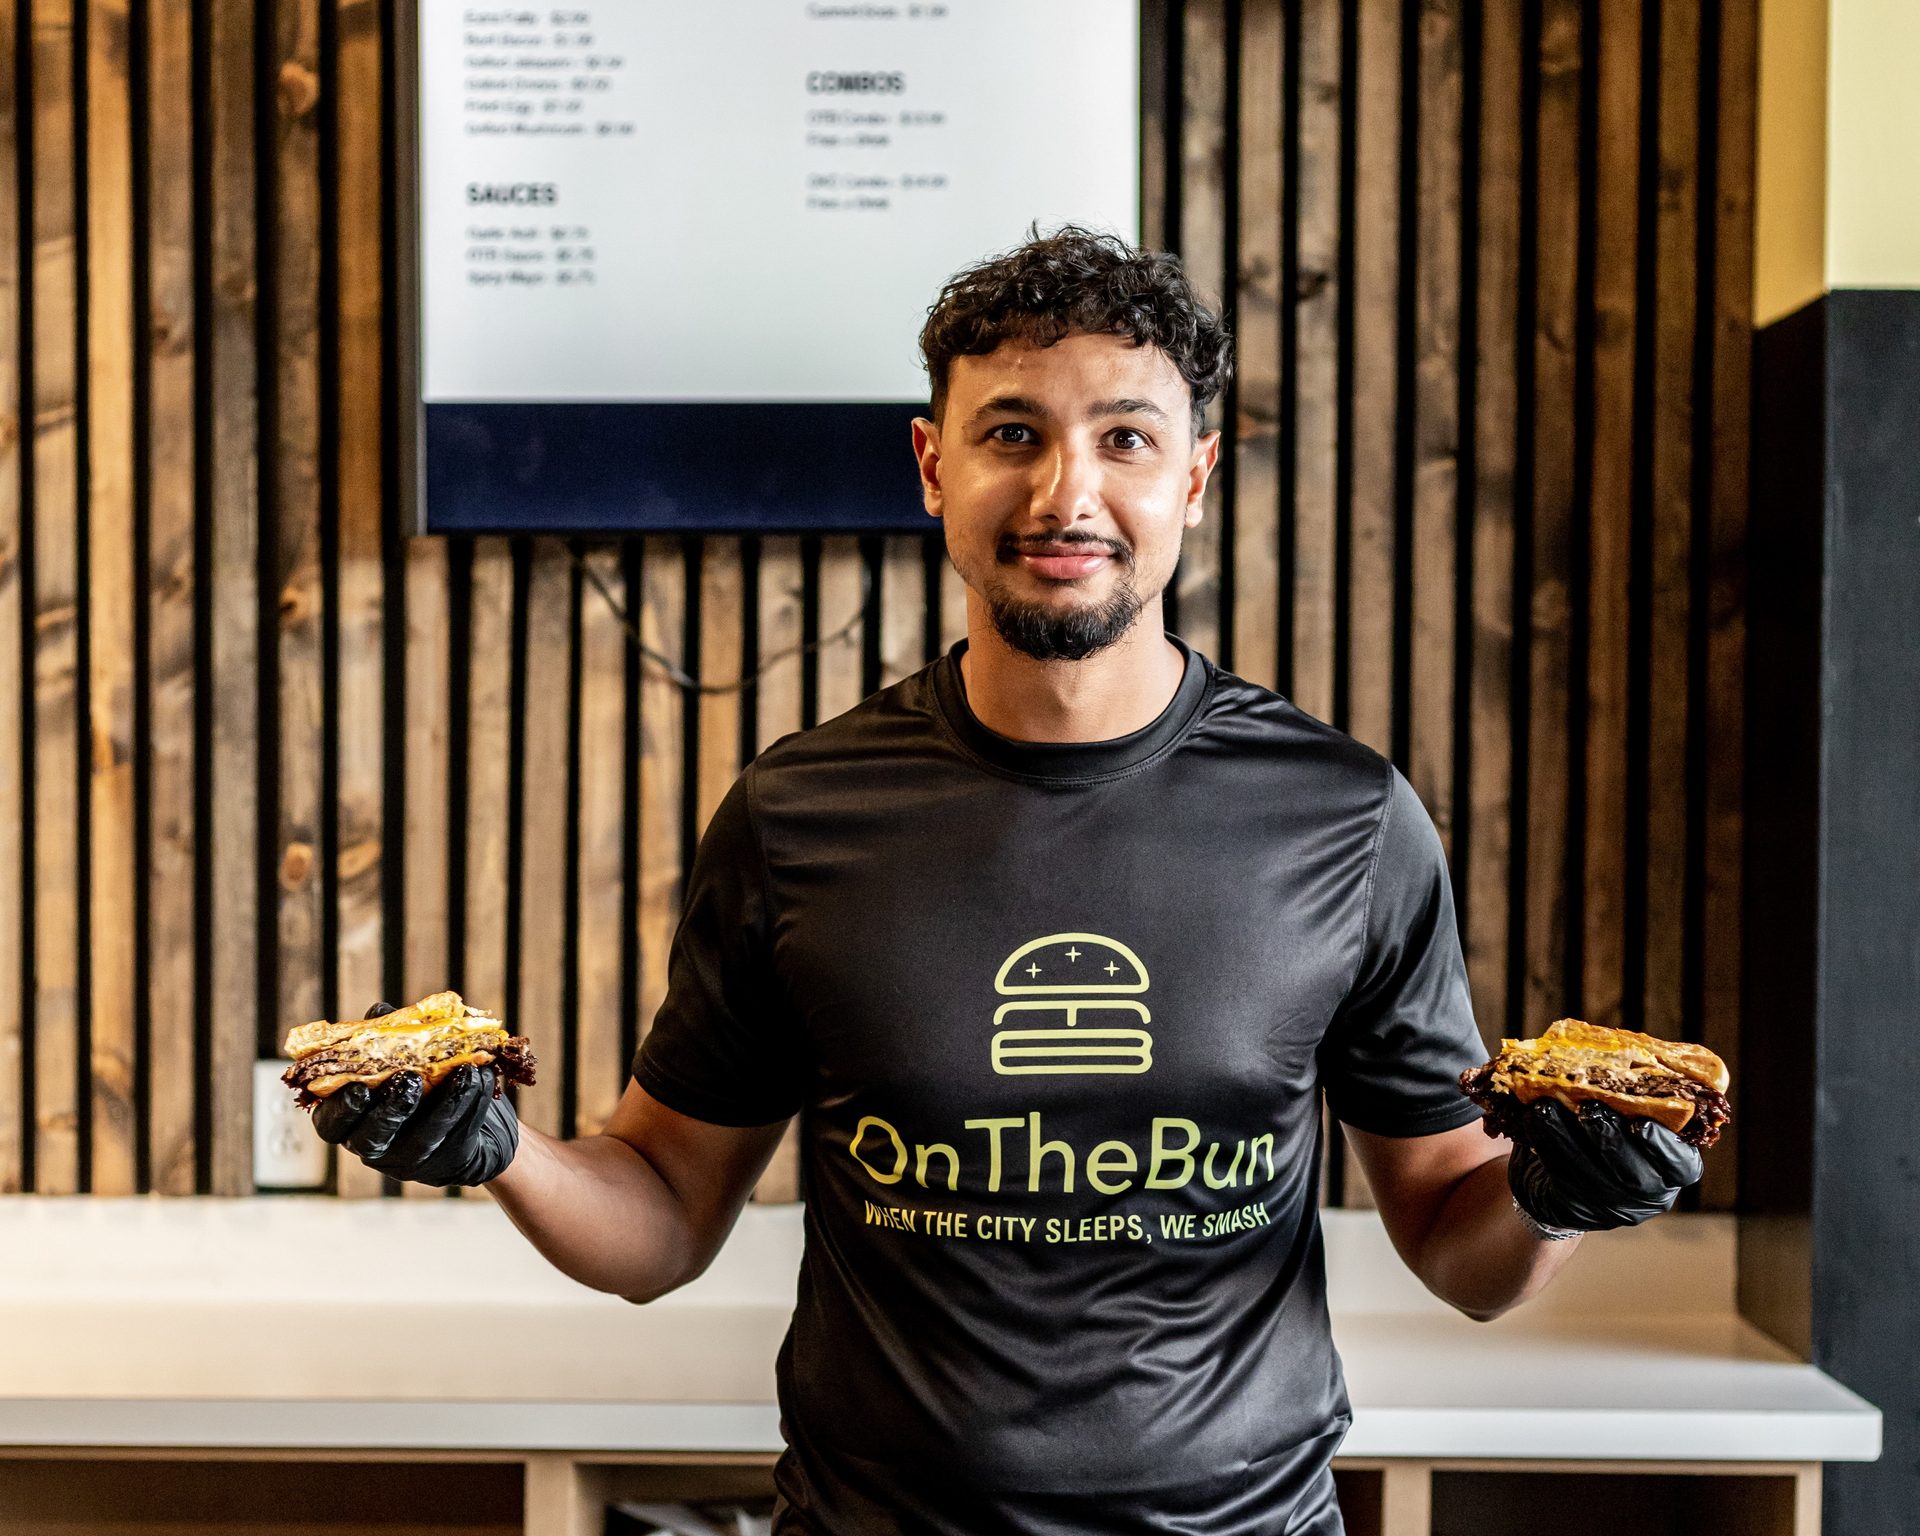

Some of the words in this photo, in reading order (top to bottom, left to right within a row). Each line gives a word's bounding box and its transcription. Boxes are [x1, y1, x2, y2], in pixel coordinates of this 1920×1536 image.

[806, 72, 904, 94] COMBOS
[467, 183, 558, 206] SAUCES
[849, 1111, 1276, 1196] OnTheBun
[864, 1200, 916, 1232] WHEN
[922, 1210, 968, 1238] THE
[976, 1215, 1037, 1243] CITY
[1044, 1213, 1154, 1245] SLEEPS,
[1159, 1213, 1197, 1240] WE
[1201, 1201, 1272, 1238] SMASH
